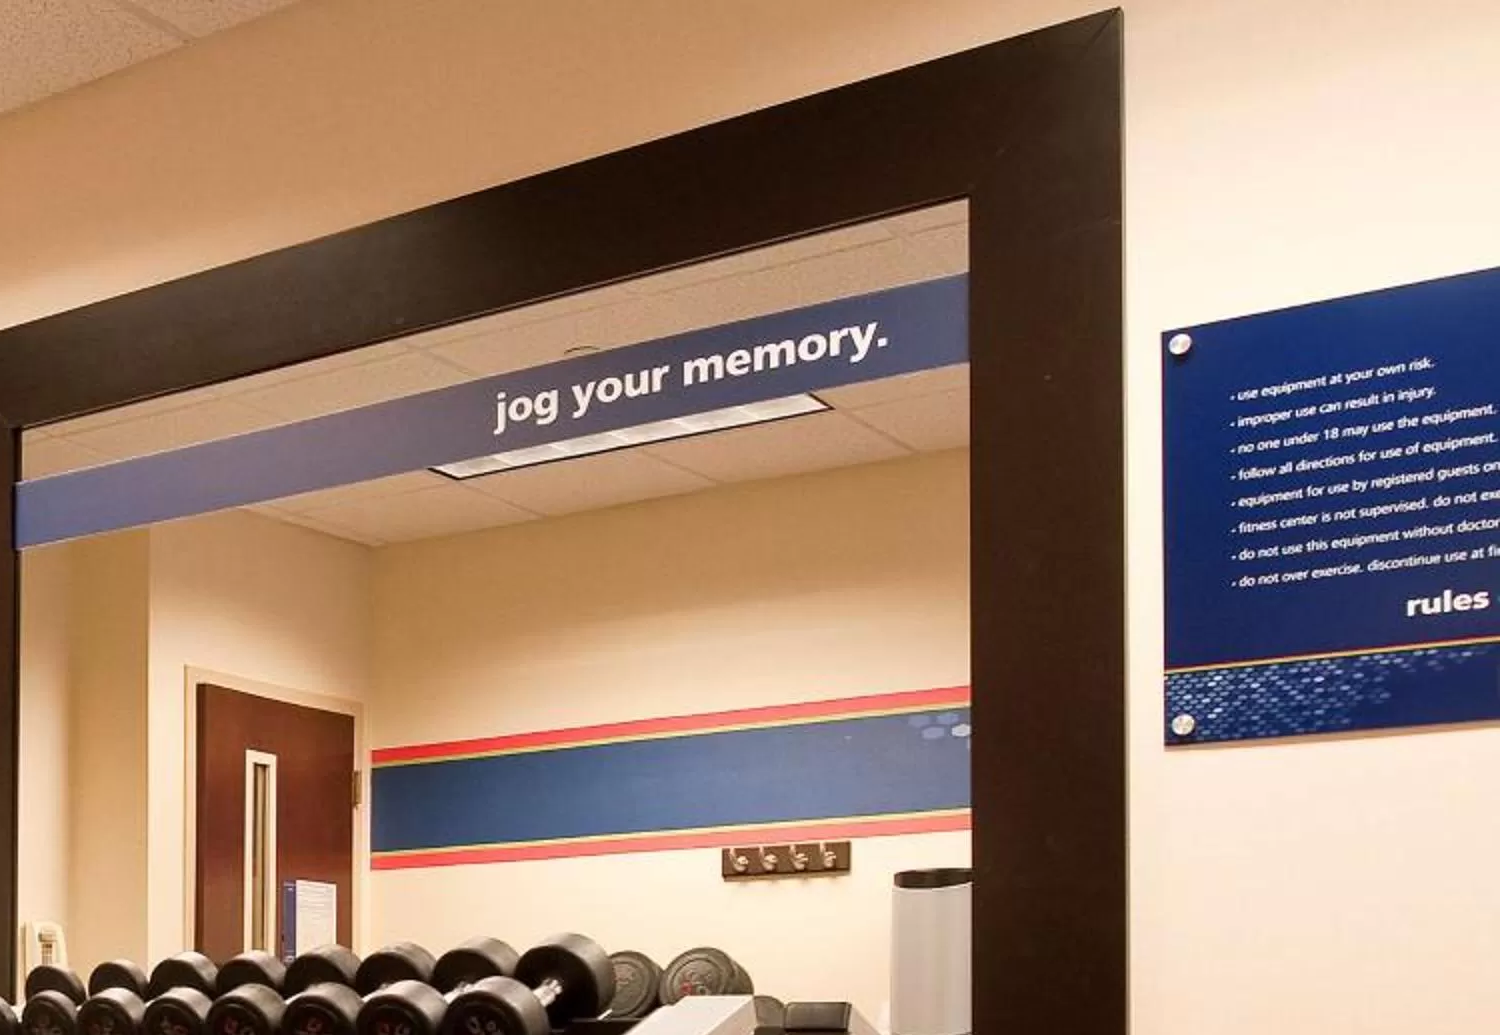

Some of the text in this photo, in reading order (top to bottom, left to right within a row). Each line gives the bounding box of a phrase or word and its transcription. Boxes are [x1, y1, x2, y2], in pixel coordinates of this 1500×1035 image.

[493, 321, 888, 435] jog your memory.
[1238, 389, 1258, 401] use
[1261, 376, 1326, 397] equipment
[1329, 373, 1342, 385] at
[1345, 368, 1374, 385] your
[1377, 363, 1405, 377] own
[1238, 409, 1293, 428] improper
[1295, 406, 1317, 418] use
[1319, 402, 1342, 413] can
[1345, 393, 1379, 410] result
[1382, 391, 1395, 403] in
[1238, 443, 1255, 455] no
[1257, 439, 1281, 451] one
[1283, 432, 1320, 447] under
[1323, 427, 1339, 440] 18
[1342, 424, 1369, 438] may
[1371, 421, 1395, 433] use
[1397, 416, 1419, 429] the
[1239, 466, 1277, 480] follow
[1279, 461, 1293, 474] all
[1296, 453, 1355, 472] directions
[1358, 449, 1377, 462] for
[1380, 447, 1402, 459] use
[1405, 442, 1420, 455] of
[1238, 488, 1303, 508] equipment
[1307, 485, 1325, 497] for
[1328, 483, 1350, 494] use
[1352, 479, 1368, 492] by
[1371, 467, 1434, 489] registered
[1437, 463, 1480, 483] guests
[1239, 520, 1278, 534] fitness
[1280, 514, 1318, 529] center
[1322, 512, 1331, 523] is
[1334, 508, 1357, 521] not
[1433, 495, 1451, 508] do
[1454, 491, 1477, 505] not
[1239, 549, 1256, 561] do
[1258, 546, 1279, 558] not
[1282, 543, 1303, 555] use
[1306, 540, 1329, 552] this
[1331, 530, 1400, 549] equipment
[1402, 523, 1453, 540] without
[1239, 576, 1256, 588] do
[1257, 573, 1280, 585] not
[1282, 570, 1309, 583] over
[1367, 554, 1442, 572] discontinue
[1445, 551, 1468, 563] use
[1471, 547, 1485, 559] at
[1407, 589, 1490, 617] rules
